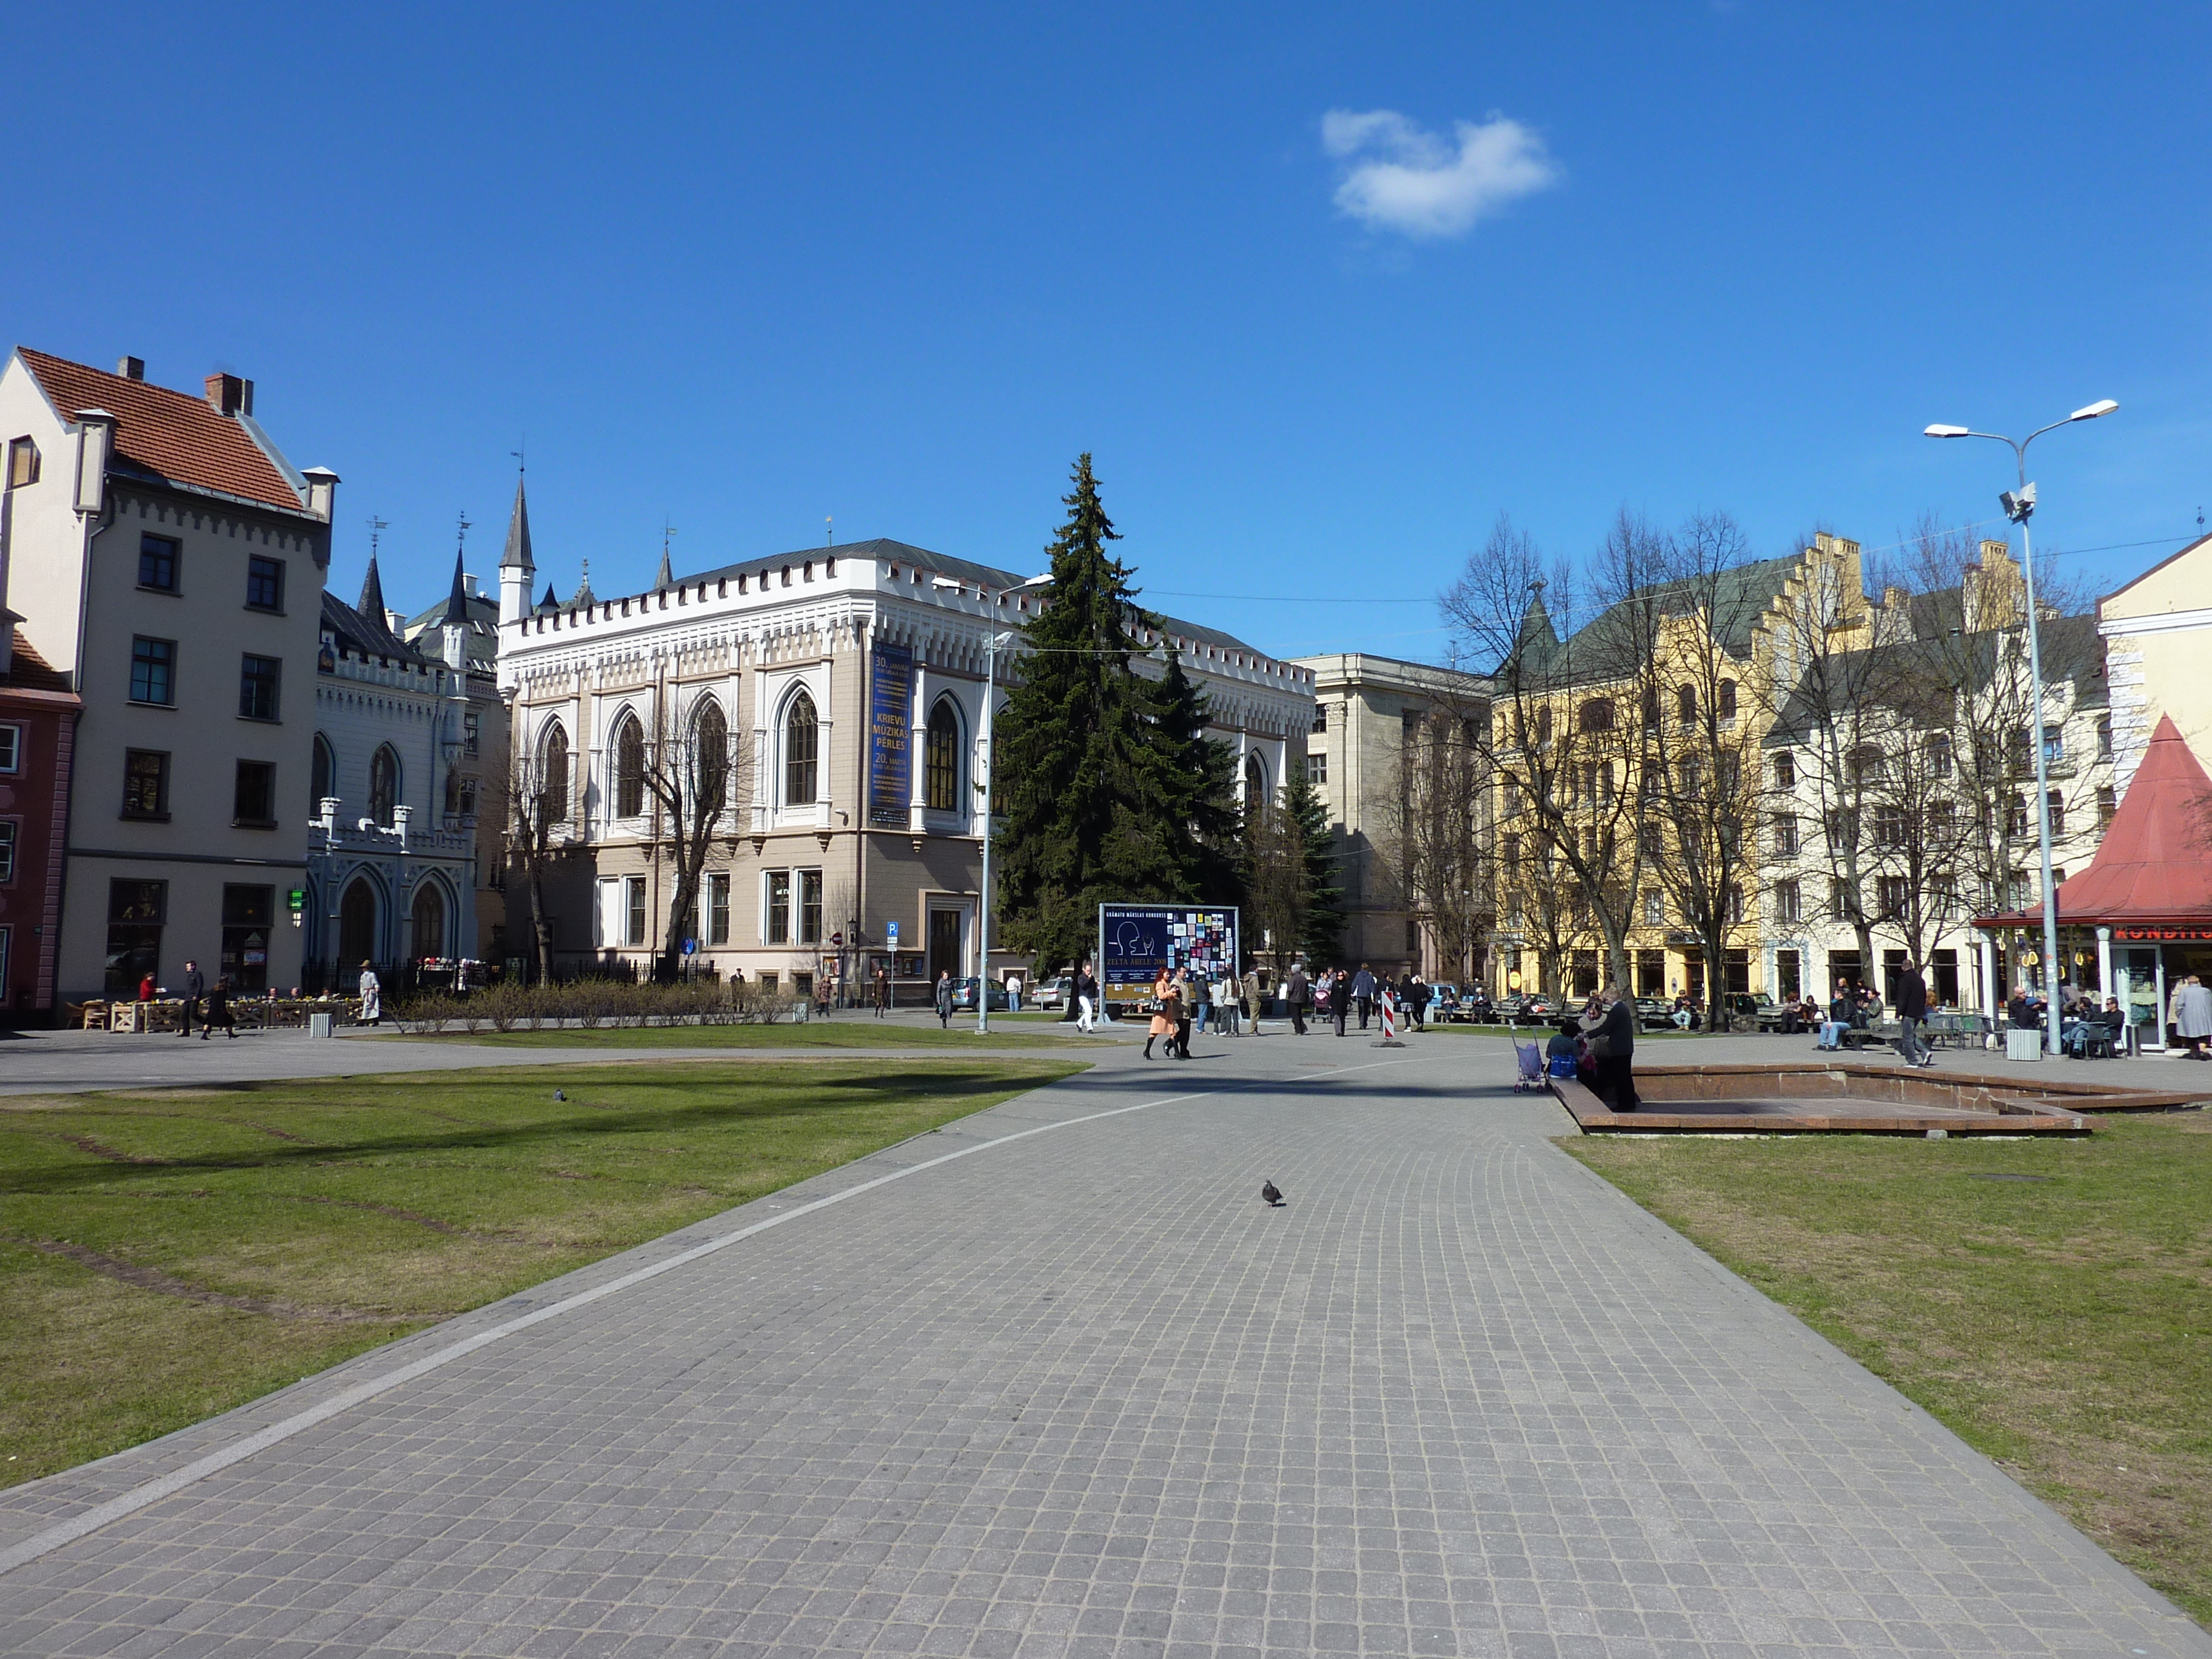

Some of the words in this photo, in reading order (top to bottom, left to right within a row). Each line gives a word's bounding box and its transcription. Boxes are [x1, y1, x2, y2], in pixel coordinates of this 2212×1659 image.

[876, 656, 888, 669] 30.
[877, 712, 906, 726] KRIEVU
[873, 724, 909, 739] MŪZIKAS
[876, 736, 905, 750] PĒRLES
[875, 752, 888, 764] 20.
[889, 923, 896, 934] P
